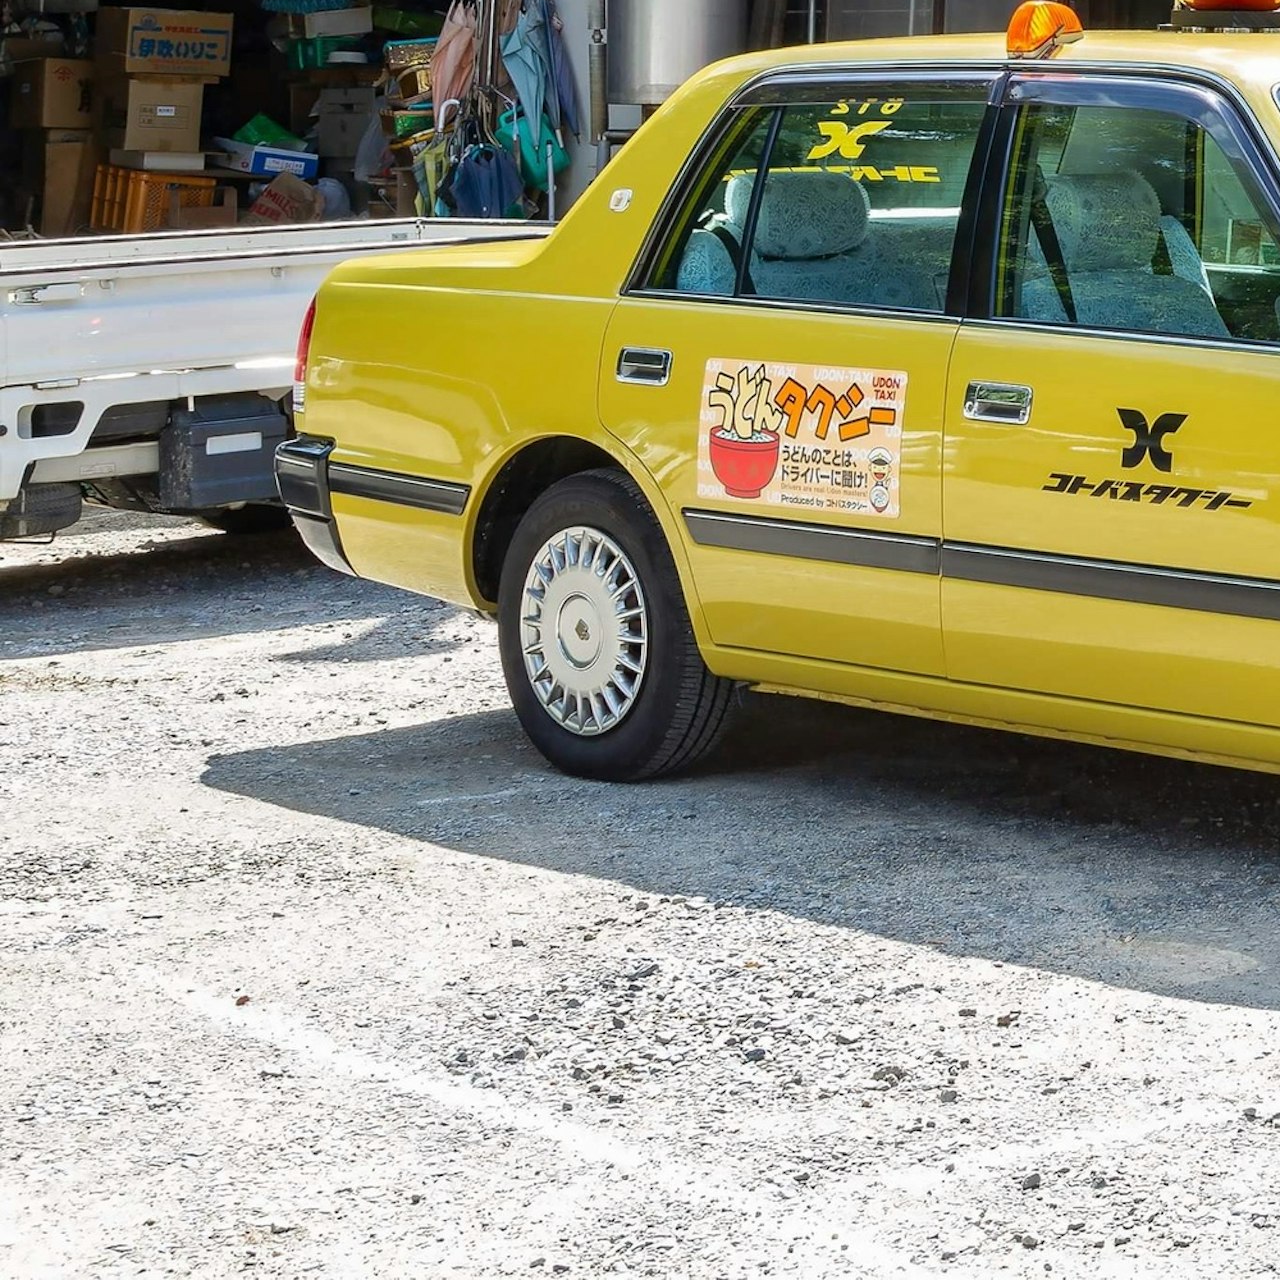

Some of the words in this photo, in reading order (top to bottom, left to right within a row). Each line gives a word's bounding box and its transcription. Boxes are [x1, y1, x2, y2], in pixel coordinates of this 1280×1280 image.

[872, 376, 901, 389] UDON
[874, 389, 897, 401] TAXI
[781, 445, 858, 468] うどんのことは、
[1042, 473, 1252, 510] コトバスタクシー
[781, 494, 815, 506] Produced
[816, 498, 824, 507] by
